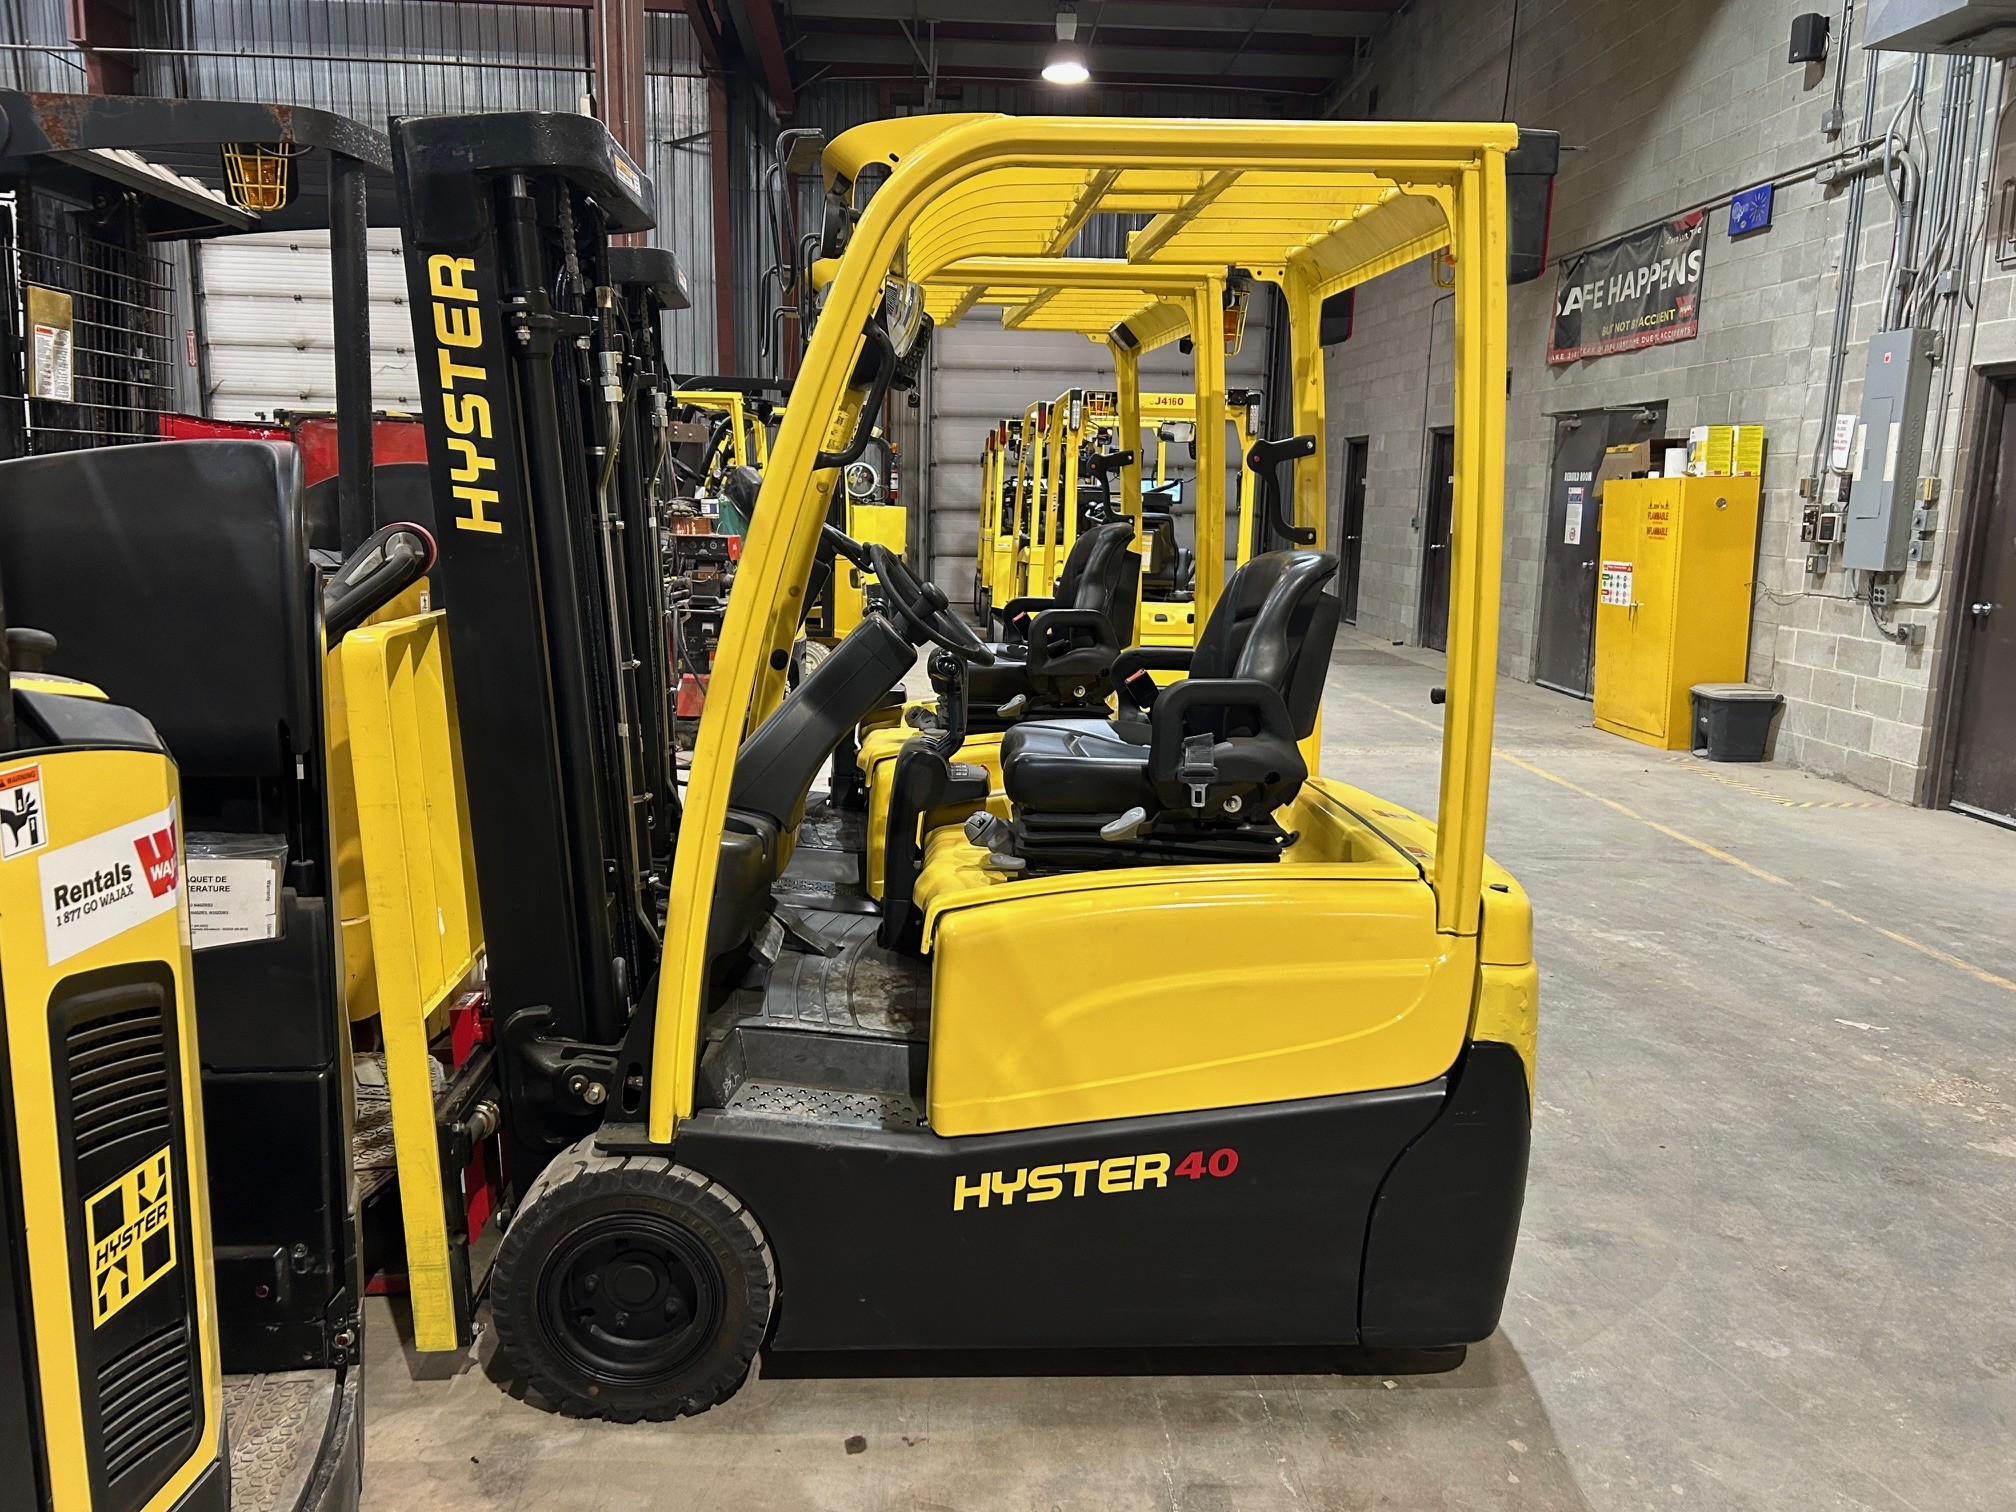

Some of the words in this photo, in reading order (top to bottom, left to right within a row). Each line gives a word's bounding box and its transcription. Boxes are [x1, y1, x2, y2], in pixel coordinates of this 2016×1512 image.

[1608, 249, 1703, 306] HAPPENS
[1614, 320, 1631, 333] NOT
[428, 254, 503, 534] HYSTER
[1154, 397, 1184, 406] J4160
[6, 770, 35, 784] WARNING
[54, 862, 132, 911] Rentals
[215, 875, 227, 883] DE
[56, 915, 62, 927] 1
[63, 906, 81, 924] 877
[83, 899, 98, 914] GO
[99, 883, 134, 908] WAJAX
[953, 1152, 1171, 1211] HYSTER
[1174, 1147, 1239, 1180] 40
[95, 1200, 168, 1270] HYSTER
